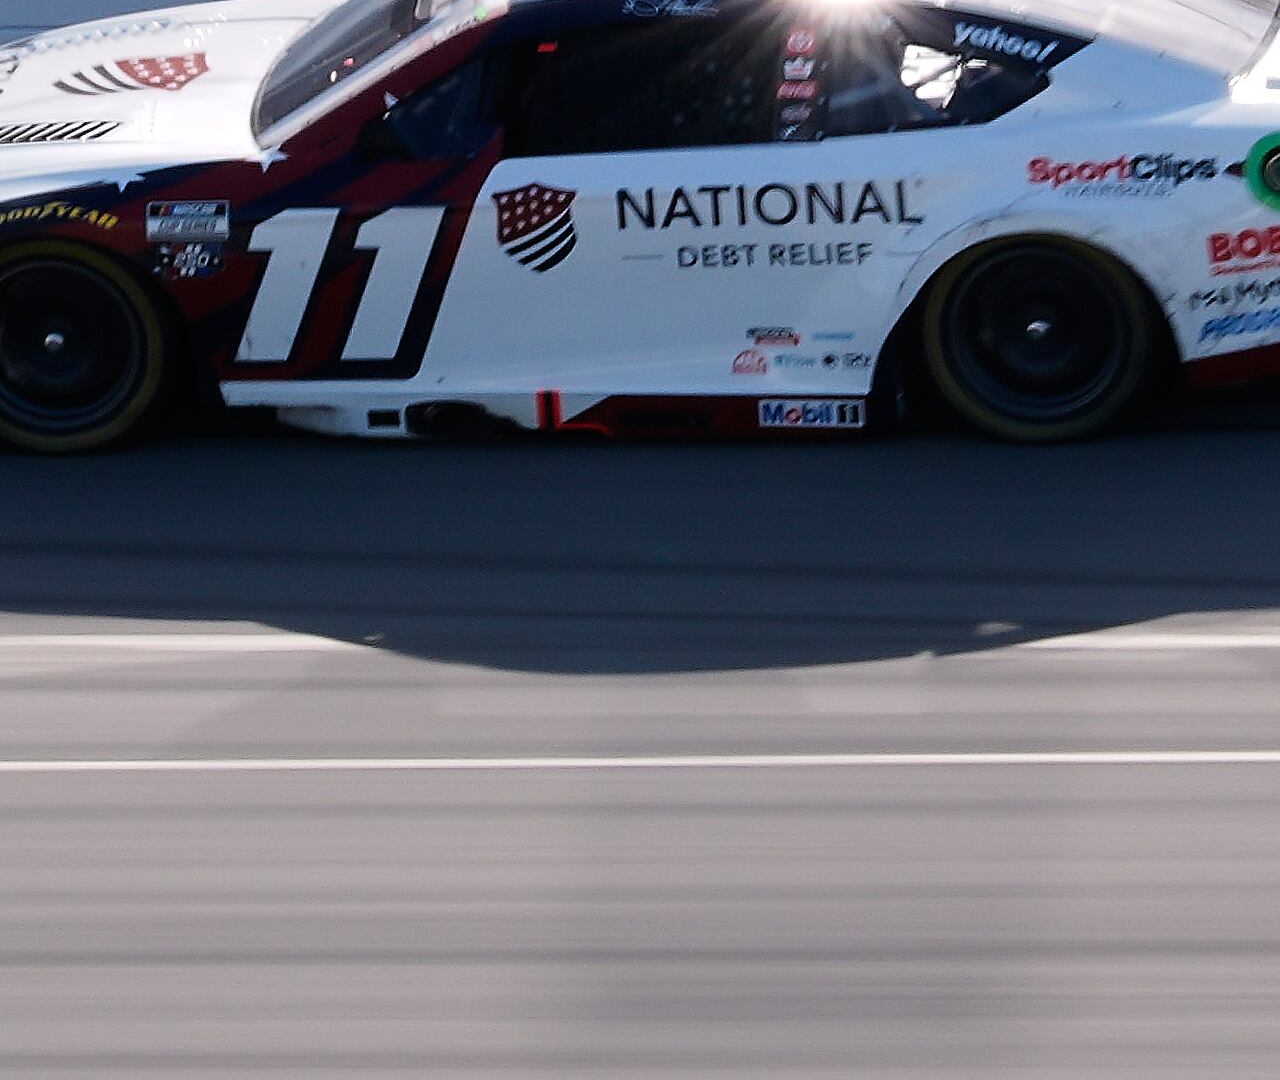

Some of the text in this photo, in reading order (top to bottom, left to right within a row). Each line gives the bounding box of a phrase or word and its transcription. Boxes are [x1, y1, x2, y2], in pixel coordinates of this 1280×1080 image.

[953, 22, 1061, 63] yahoo!
[615, 180, 924, 229] NATIONAL
[677, 242, 874, 268] DEBT RELIEF
[234, 206, 448, 362] 11
[762, 402, 833, 424] Mobil
